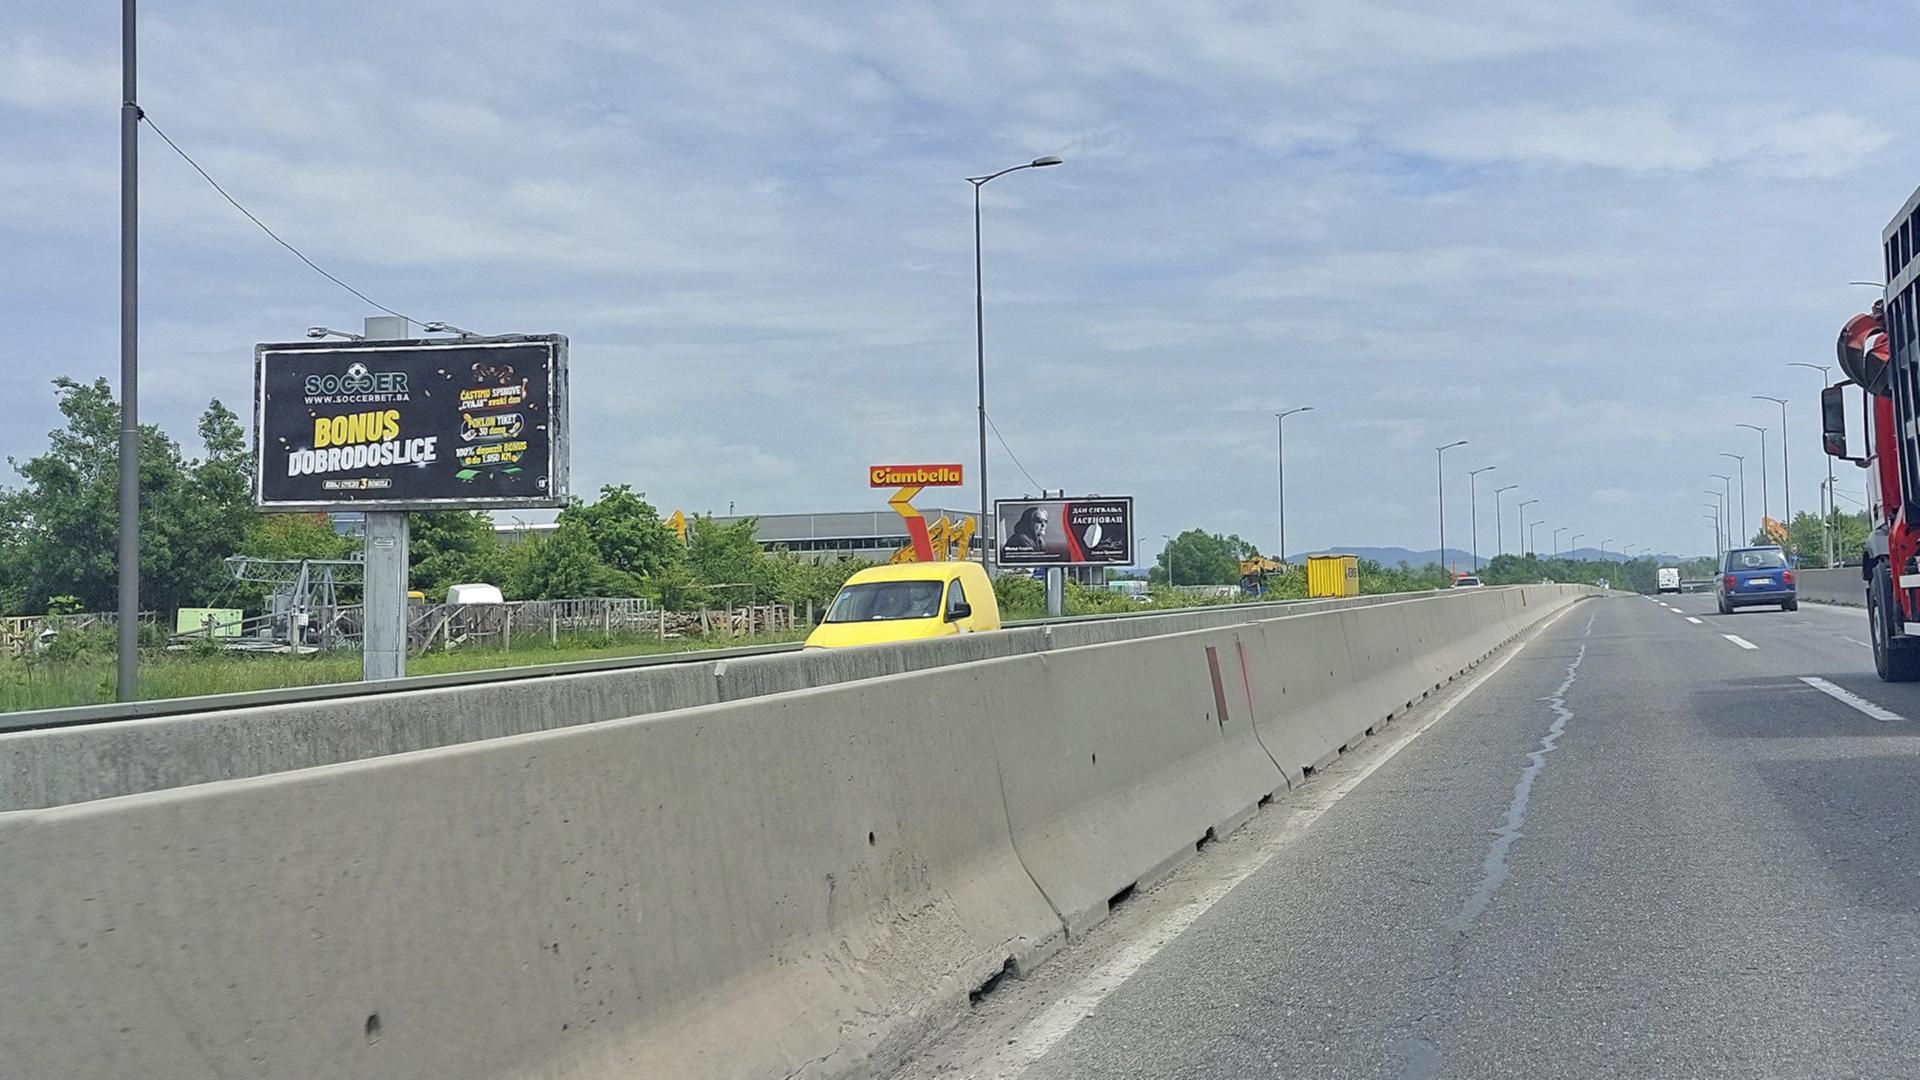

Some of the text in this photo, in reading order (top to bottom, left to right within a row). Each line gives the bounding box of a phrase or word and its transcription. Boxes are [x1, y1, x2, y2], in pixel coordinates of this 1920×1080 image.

[304, 394, 410, 404] WWW.SOCCERBET.BA
[496, 414, 517, 426] TIKET
[314, 409, 400, 448] BONUS
[455, 447, 475, 458] 100%
[872, 467, 961, 484] Ciambella
[361, 478, 368, 489] 3
[1072, 506, 1088, 514] ДАН
